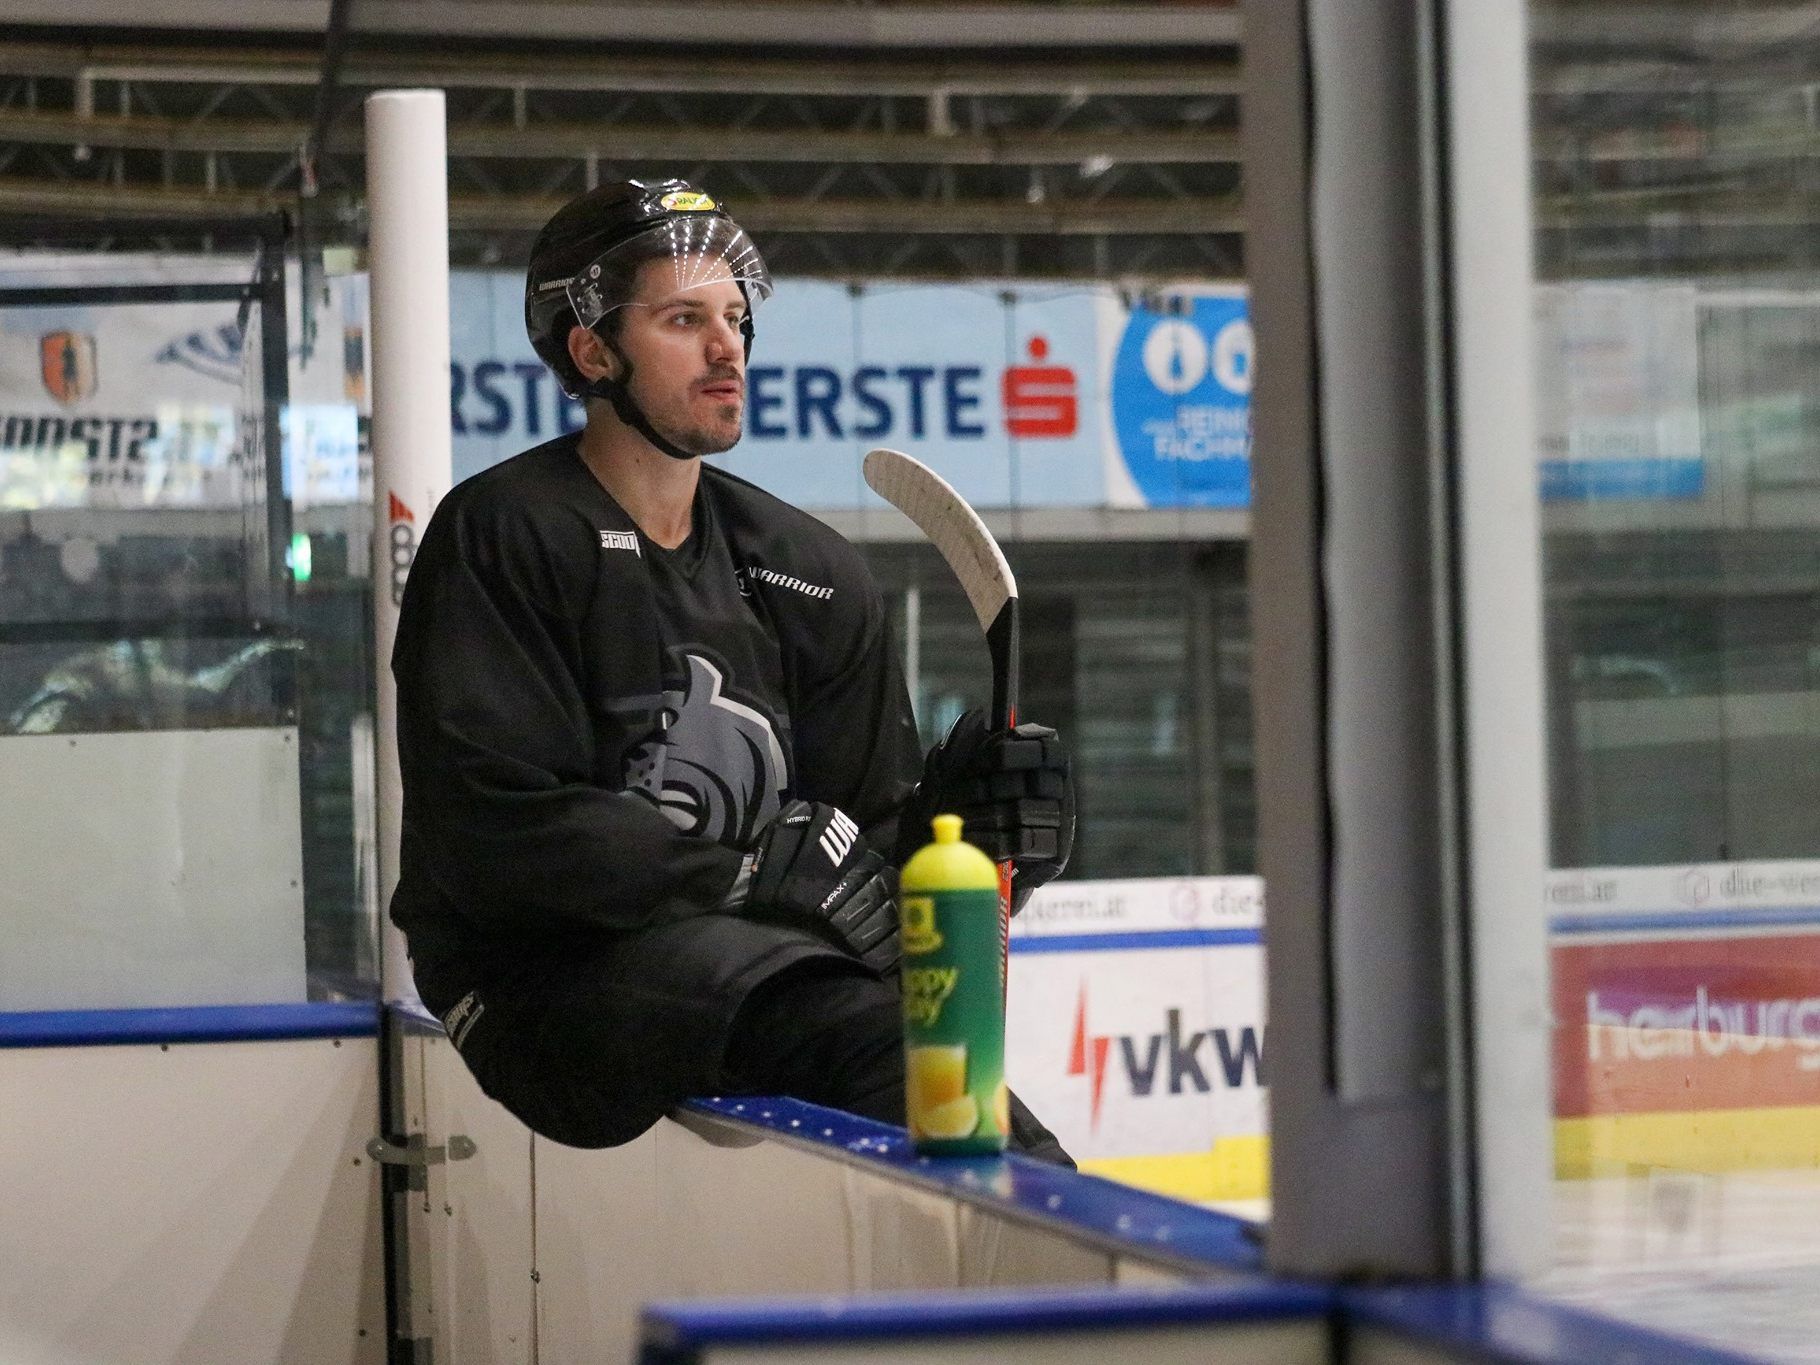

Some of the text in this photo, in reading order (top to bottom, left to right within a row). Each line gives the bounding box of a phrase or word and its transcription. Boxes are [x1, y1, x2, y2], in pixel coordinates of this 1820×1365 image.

[747, 366, 985, 440] ERSTE
[749, 566, 834, 600] WARRIOR
[1117, 1005, 1263, 1097] vkw
